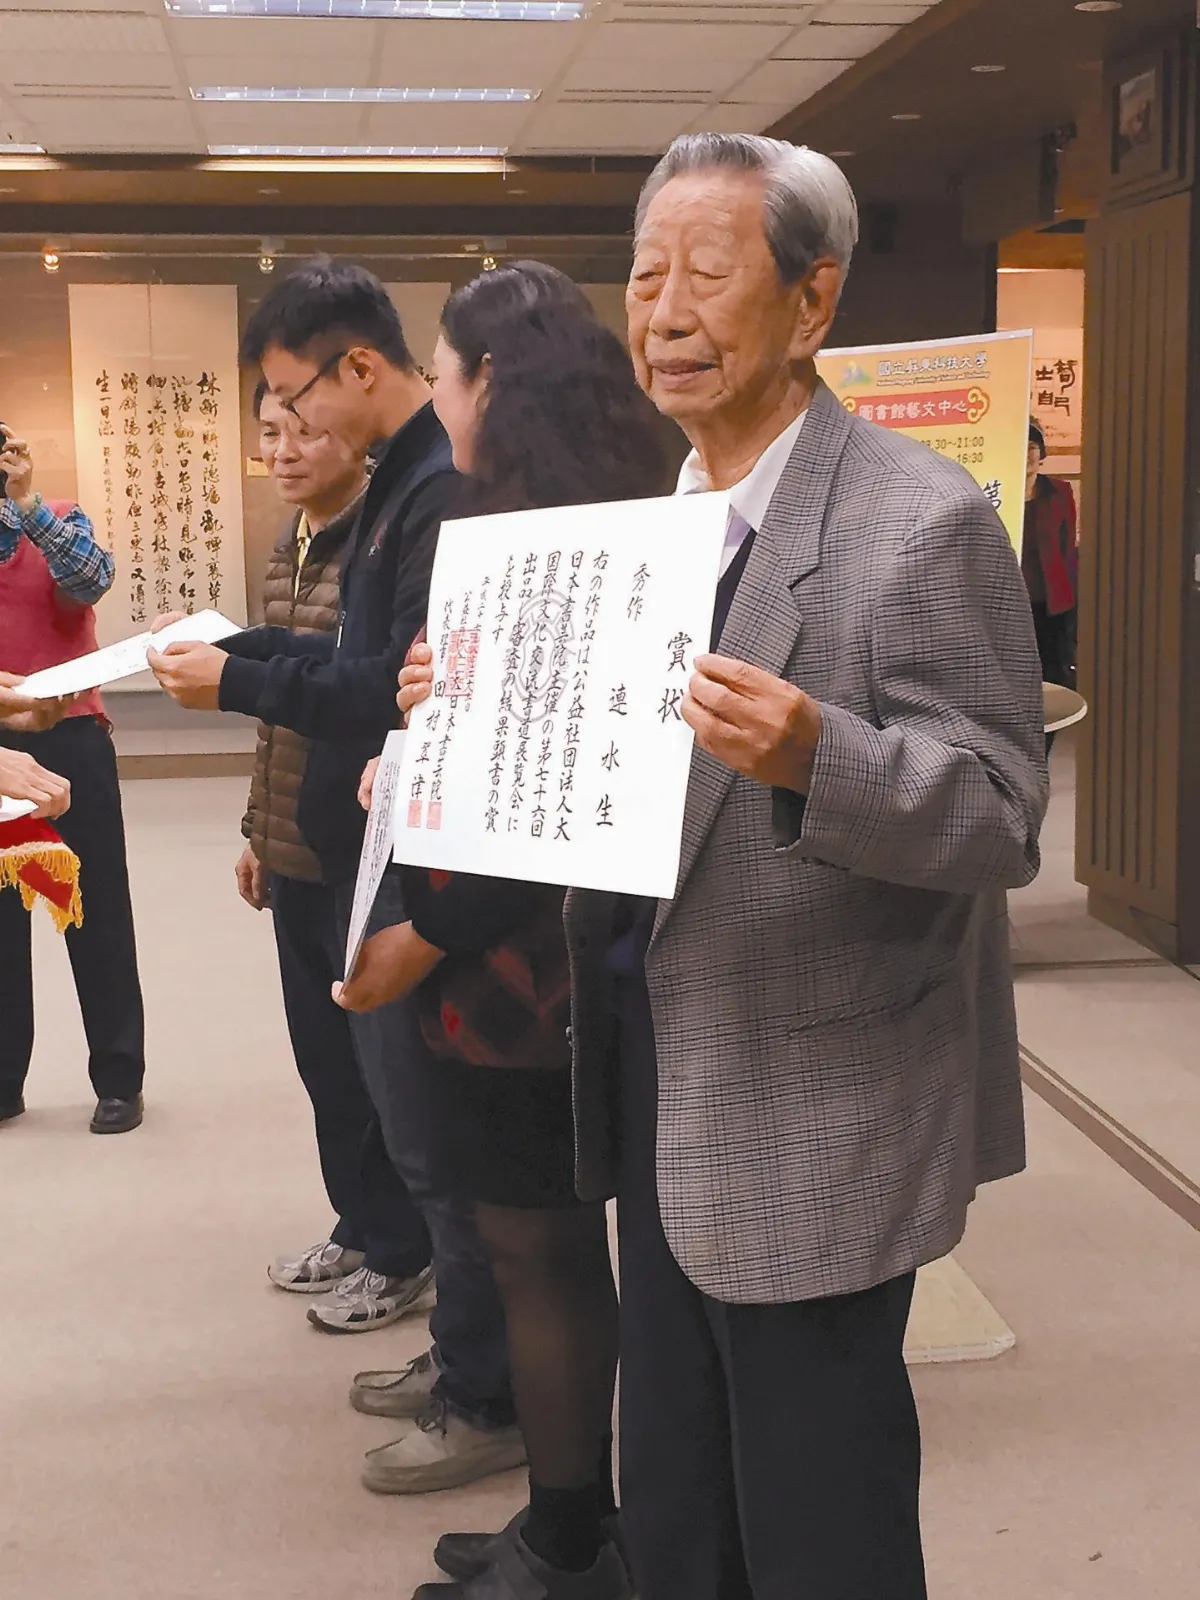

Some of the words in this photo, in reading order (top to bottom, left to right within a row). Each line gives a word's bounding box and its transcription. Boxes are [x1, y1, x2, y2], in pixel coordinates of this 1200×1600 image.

[878, 351, 989, 376] 國立屏東科技大學
[858, 400, 968, 421] 圖書館藝文中心
[627, 563, 651, 622] 秀作
